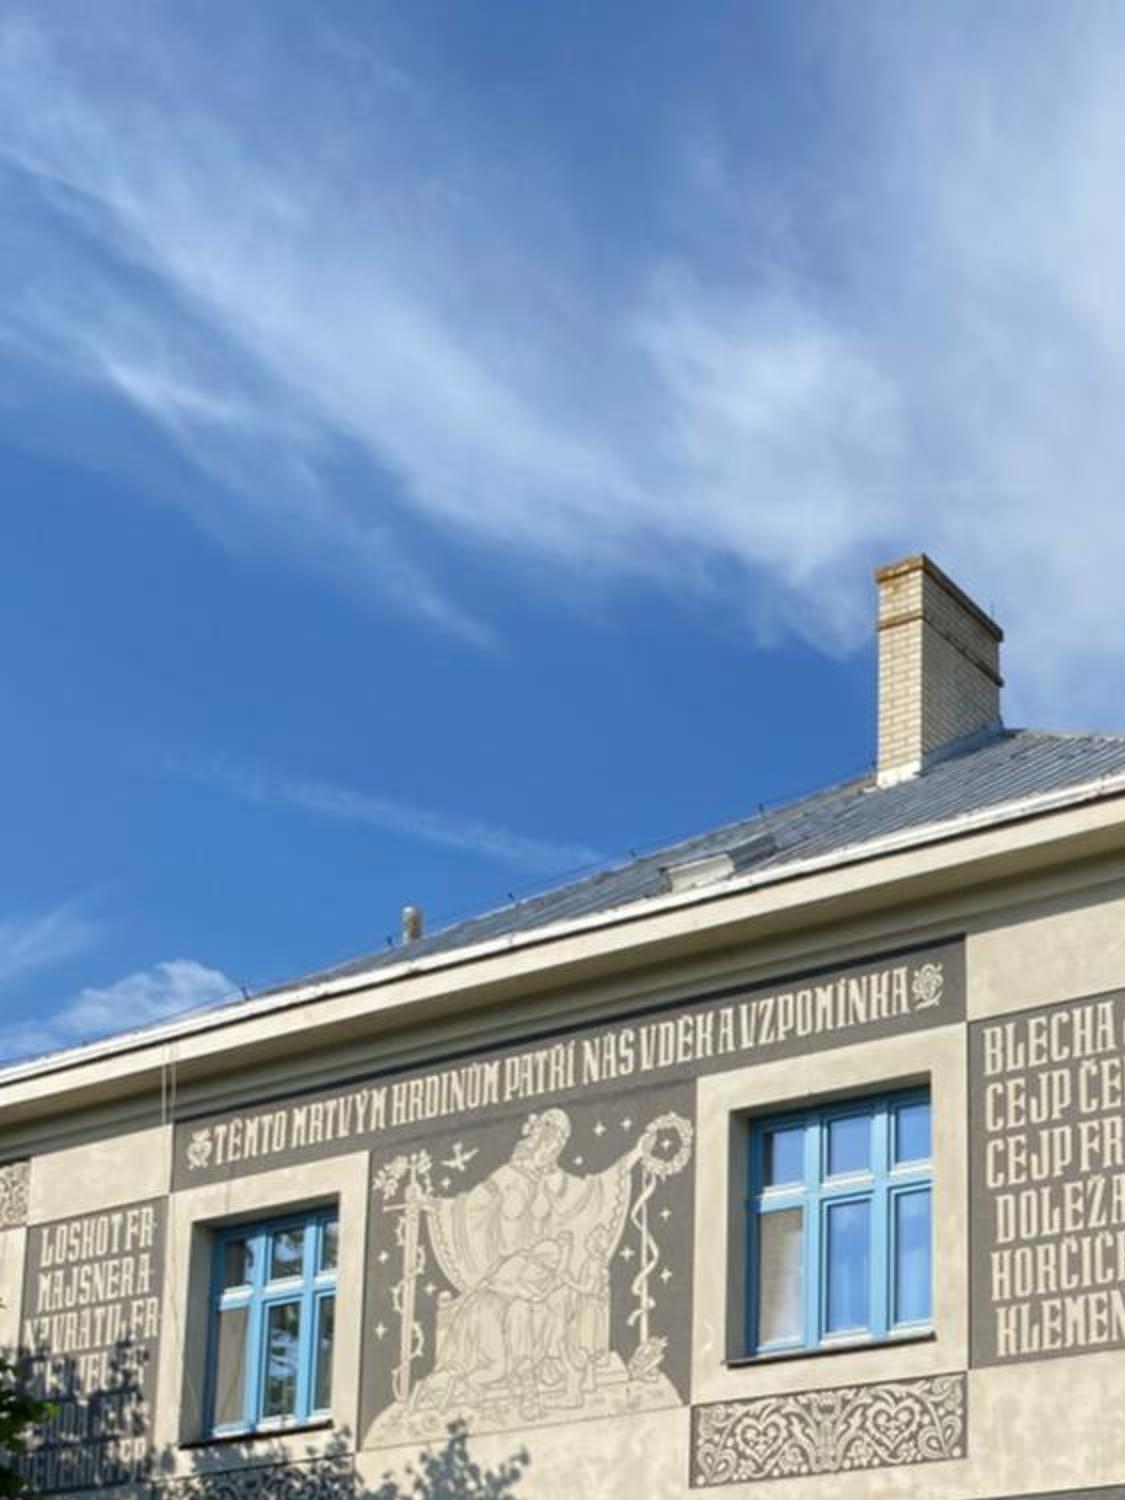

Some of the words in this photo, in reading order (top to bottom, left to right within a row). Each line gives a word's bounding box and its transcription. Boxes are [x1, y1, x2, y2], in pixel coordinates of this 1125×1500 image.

[717, 1008, 736, 1055] A
[982, 1001, 1116, 1076] BLECHA
[985, 1068, 1072, 1133] CEJP
[986, 1125, 1073, 1189] CEJP
[37, 1256, 134, 1314] MAJSNER
